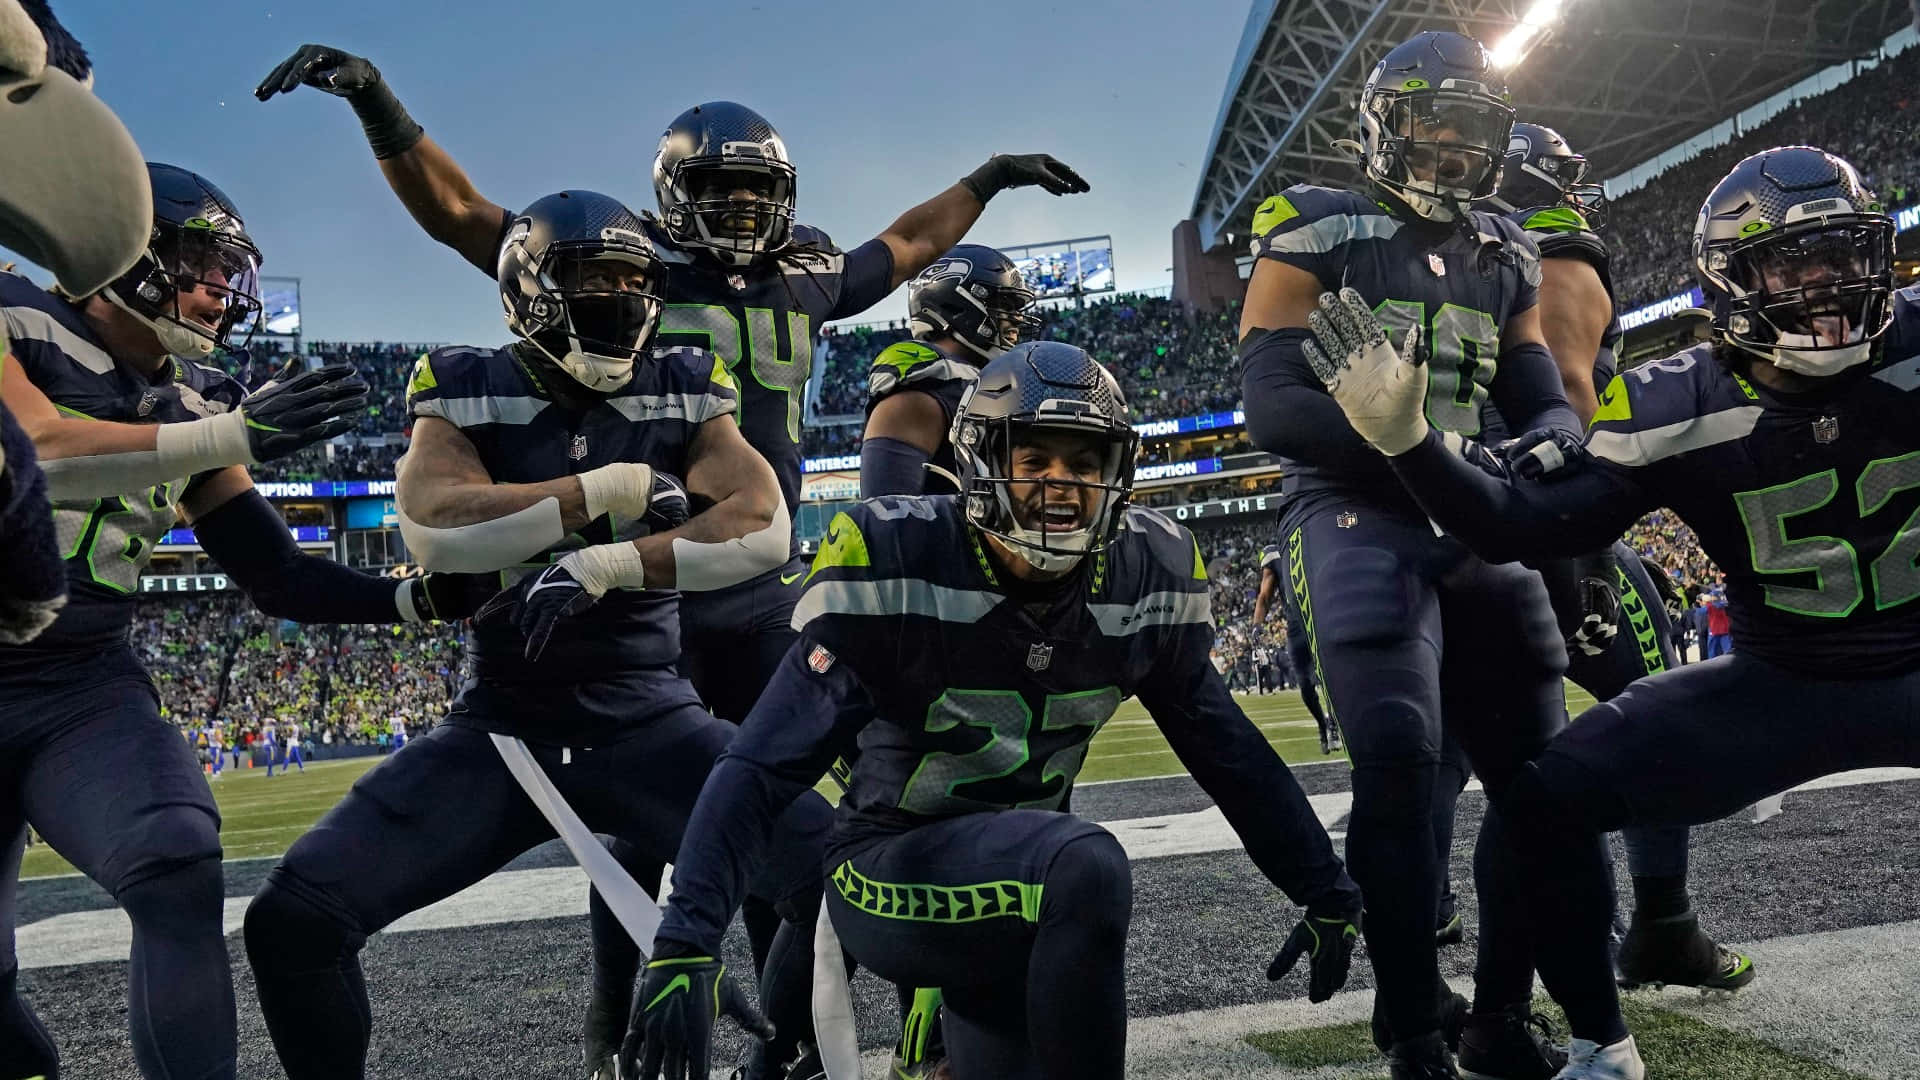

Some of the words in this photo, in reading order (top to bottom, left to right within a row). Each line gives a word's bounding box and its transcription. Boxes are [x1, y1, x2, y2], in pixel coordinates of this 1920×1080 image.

[254, 483, 313, 497] EPTION
[1176, 505, 1204, 520] OF
[1221, 497, 1267, 514] THE
[143, 577, 228, 592] FIELD
